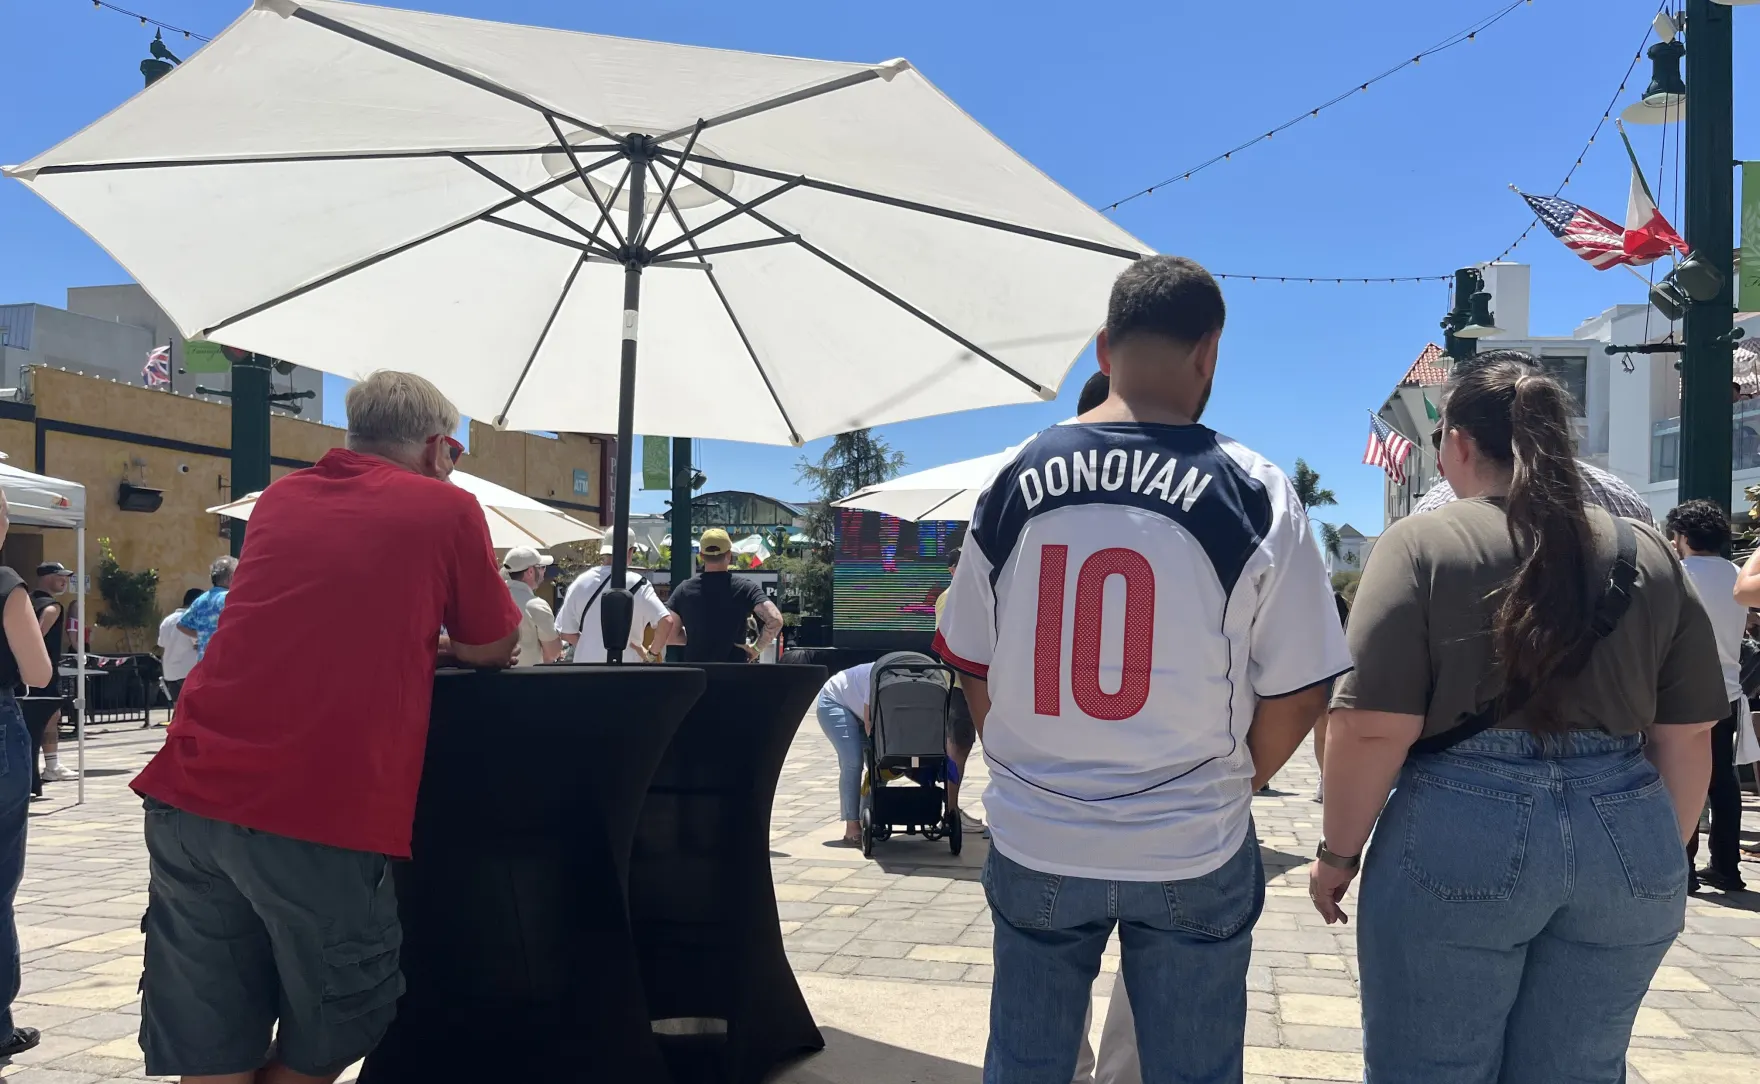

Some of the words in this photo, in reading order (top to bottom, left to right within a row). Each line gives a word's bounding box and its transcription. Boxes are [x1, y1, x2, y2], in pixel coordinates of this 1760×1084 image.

[573, 479, 589, 493] ATM
[1018, 448, 1212, 513] DONOVAN
[734, 525, 767, 534] MAYA
[1033, 544, 1156, 721] 10
